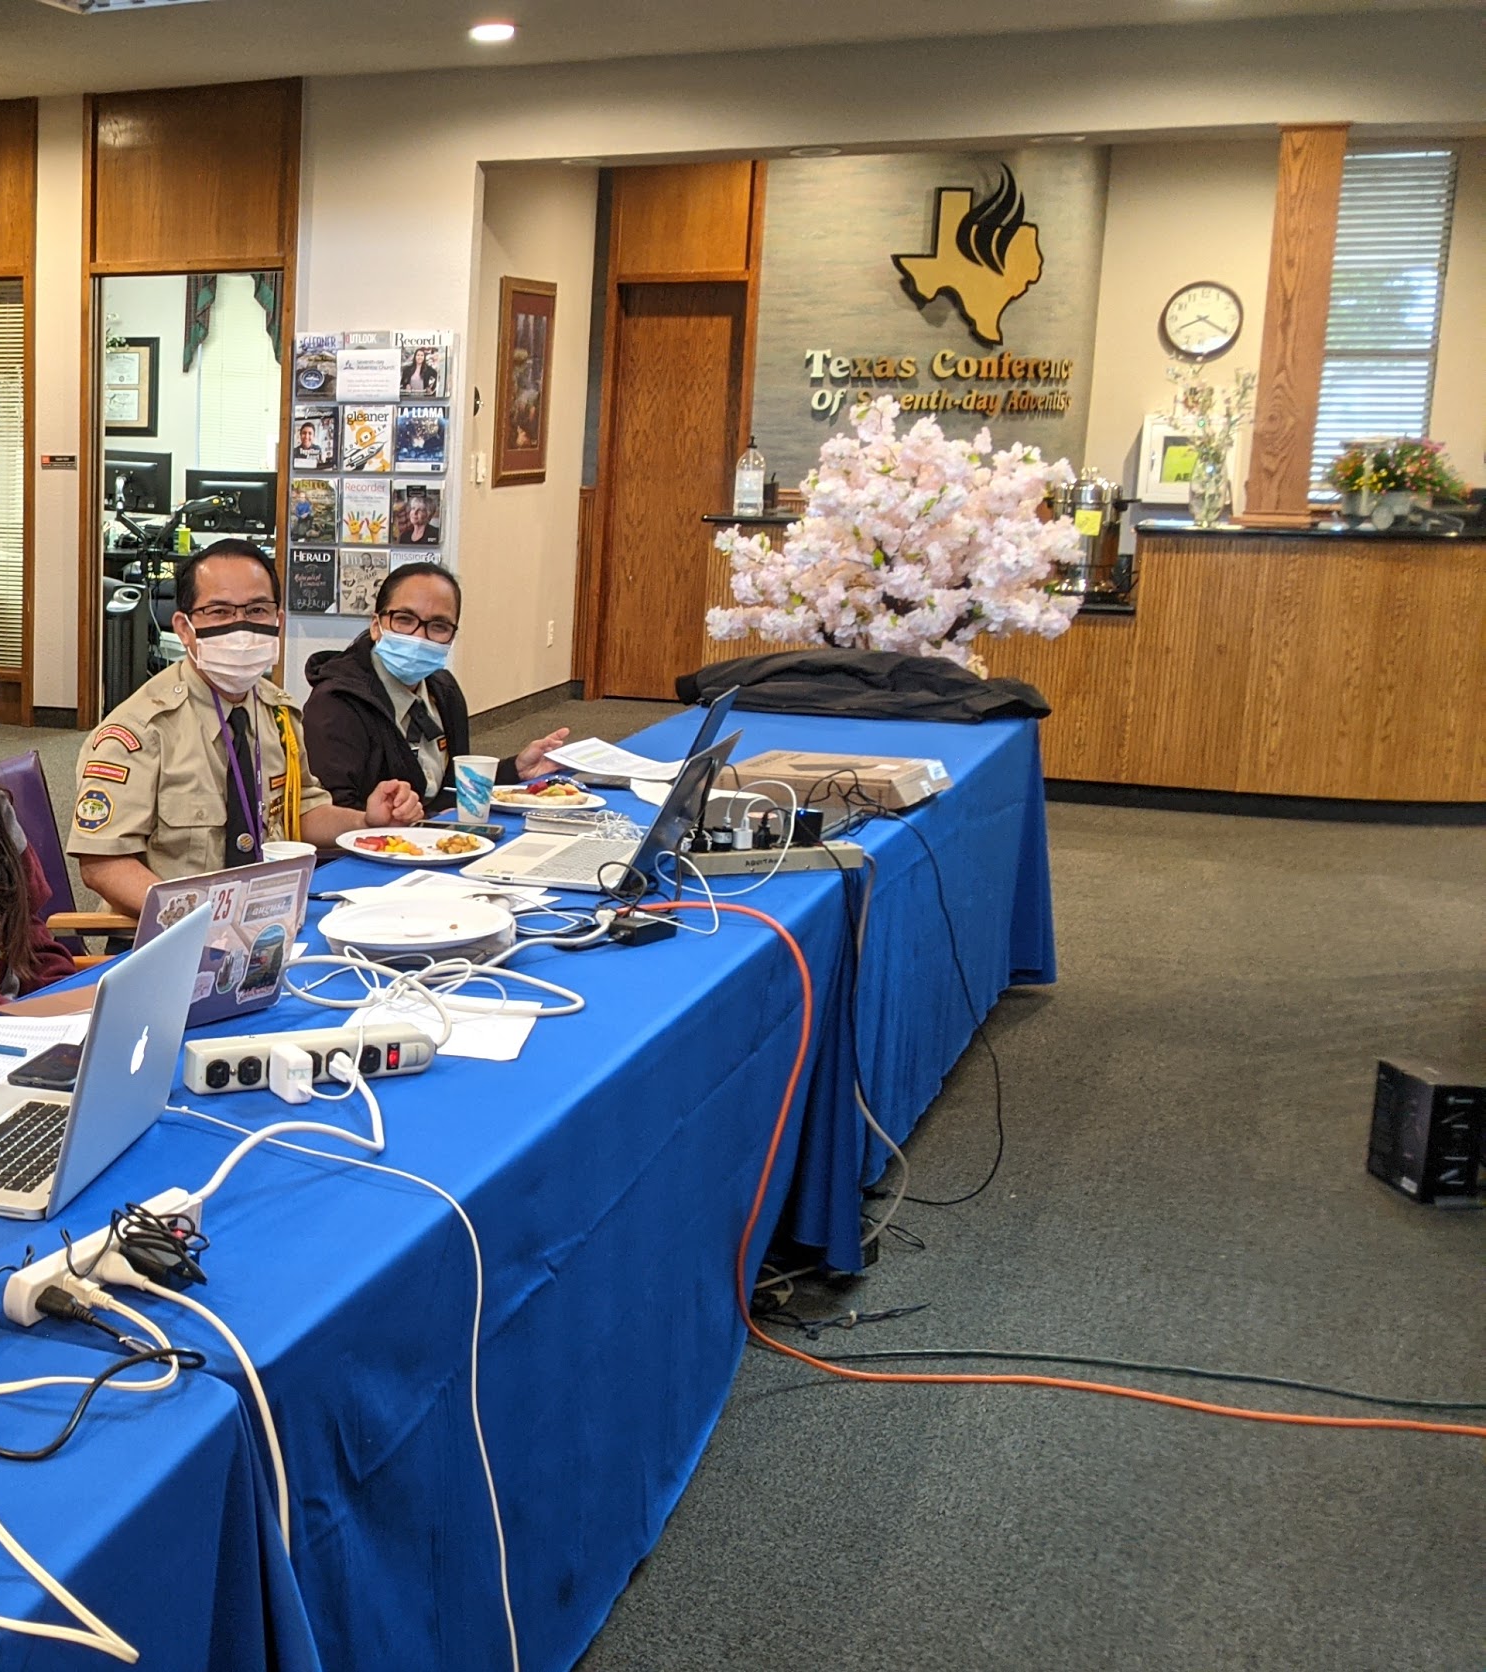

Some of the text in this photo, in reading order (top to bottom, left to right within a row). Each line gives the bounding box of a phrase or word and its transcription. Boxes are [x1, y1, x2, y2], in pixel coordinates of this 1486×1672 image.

[395, 332, 436, 346] Record
[805, 348, 917, 379] Texas
[810, 388, 847, 417] Of
[856, 387, 1001, 417] Senth-day
[346, 411, 389, 426] gleaner
[398, 407, 444, 418] LA LLAMA
[344, 482, 386, 493] Recorder
[293, 551, 331, 563] HERALD
[213, 888, 235, 921] 25
